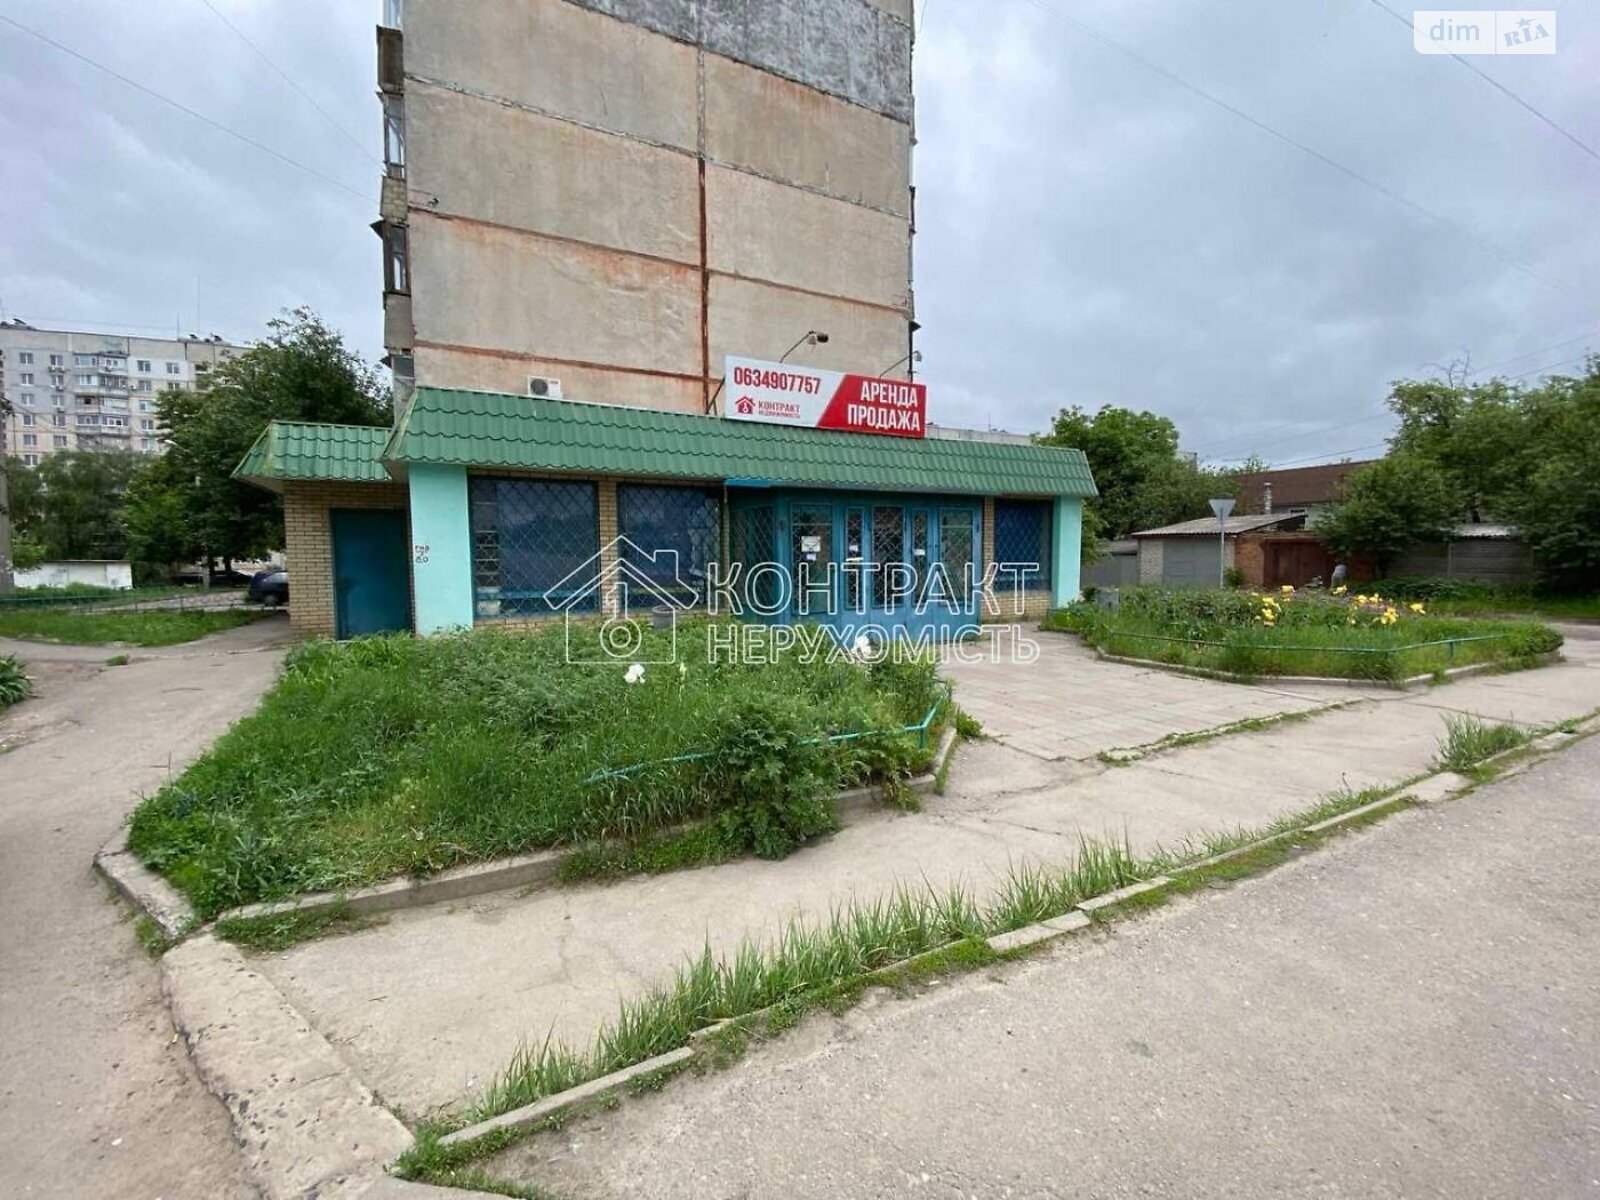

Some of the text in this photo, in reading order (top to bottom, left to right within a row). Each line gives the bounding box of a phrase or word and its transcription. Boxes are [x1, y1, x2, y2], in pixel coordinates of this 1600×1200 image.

[734, 366, 821, 394] 0634907757
[758, 400, 800, 412] КОНТРАКТ
[861, 381, 918, 406] АРЕНДА
[848, 404, 921, 431] ПРОДАЖА
